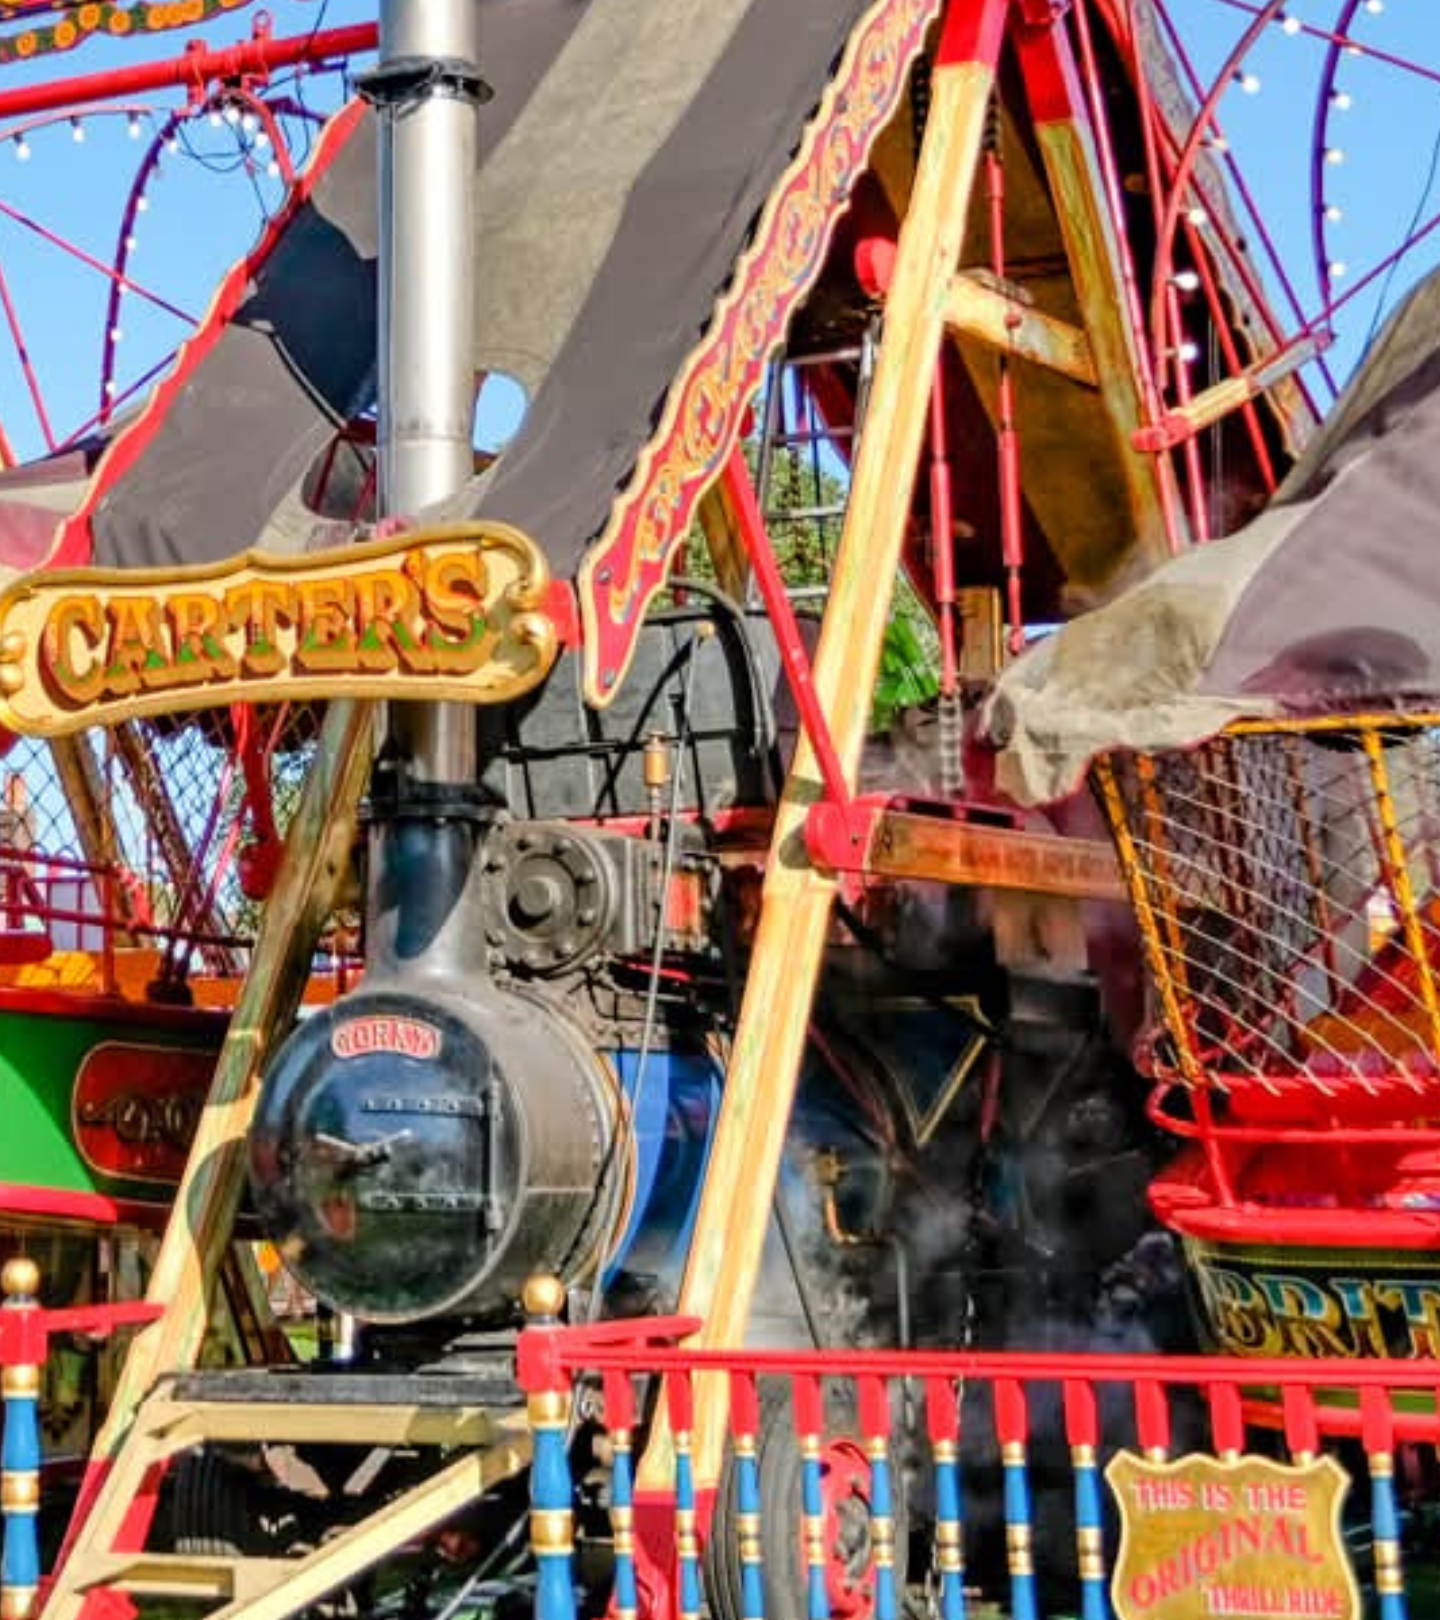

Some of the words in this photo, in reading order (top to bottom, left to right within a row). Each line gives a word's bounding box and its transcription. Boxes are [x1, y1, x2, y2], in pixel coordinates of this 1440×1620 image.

[39, 546, 492, 706] CARTER'S
[1134, 1477, 1194, 1511] THIS
[1200, 1483, 1233, 1512] IS
[1243, 1482, 1307, 1512] THE
[1129, 1514, 1325, 1609] ORIGINAL
[1200, 1584, 1285, 1616] THRILL
